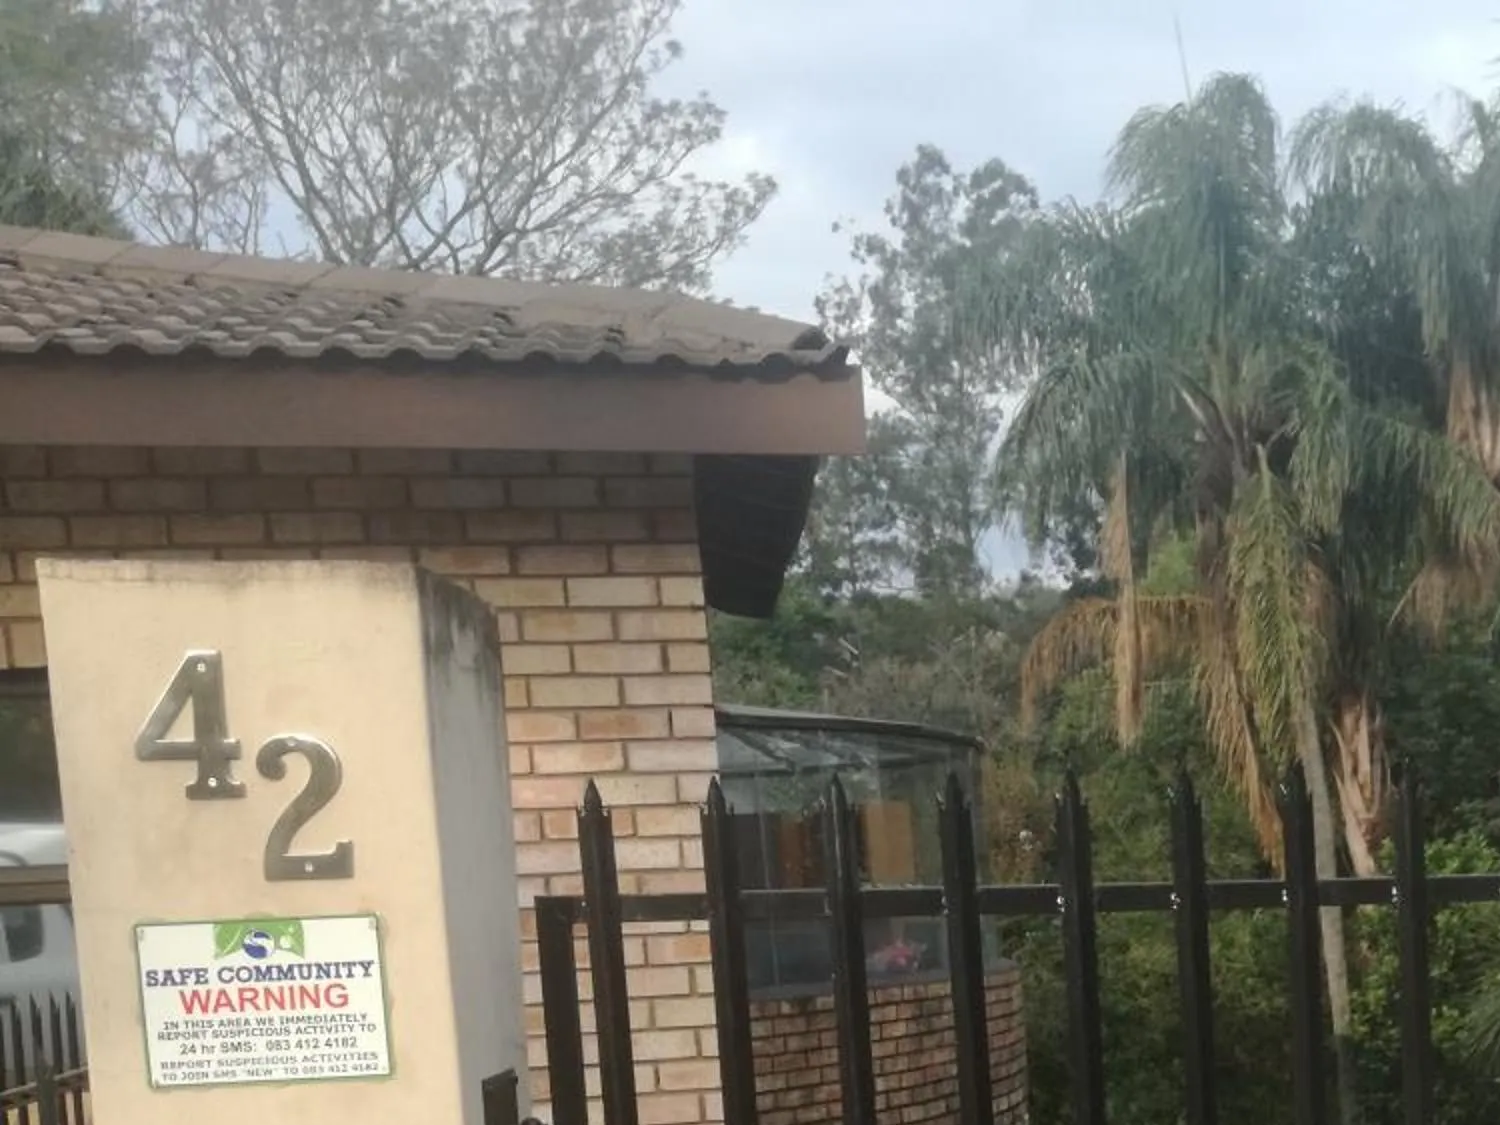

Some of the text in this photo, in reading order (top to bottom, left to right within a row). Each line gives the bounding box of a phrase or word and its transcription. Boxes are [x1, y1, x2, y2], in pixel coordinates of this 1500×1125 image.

[145, 960, 375, 988] SAFE COMMUNITY
[178, 983, 350, 1015] WARNING
[163, 1012, 368, 1031] IN THIS AREA WE IMMEDIATELY
[157, 1023, 377, 1041] REPORT SUSPICIOUS ACTIVITY TO
[180, 1042, 197, 1055] 24
[201, 1042, 217, 1054] hr
[220, 1041, 257, 1054] SMS:
[265, 1039, 291, 1052] 083
[294, 1038, 321, 1050] 412
[160, 1052, 379, 1070] REPORT SUSPICIOUS ACTIVITIES
[162, 1072, 177, 1082] TO
[181, 1071, 209, 1081] JOIN
[284, 1066, 299, 1076] TO
